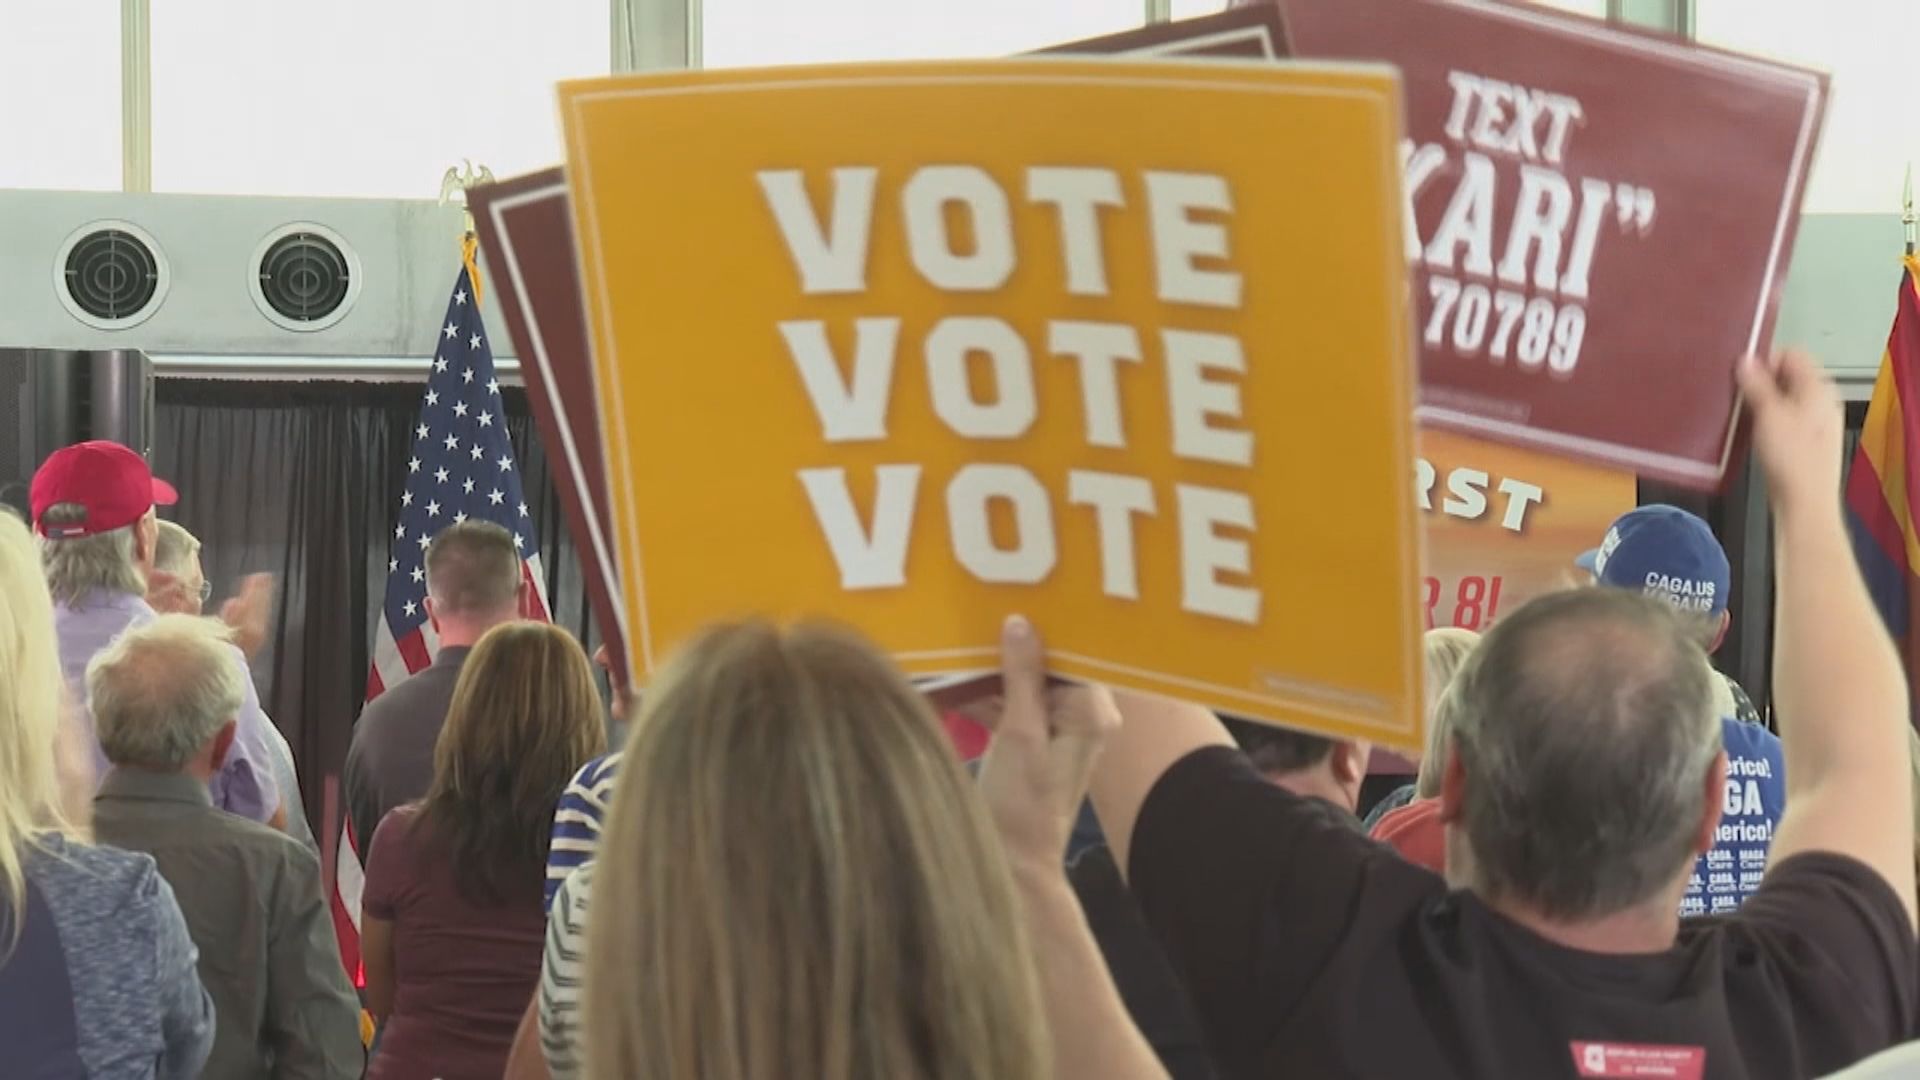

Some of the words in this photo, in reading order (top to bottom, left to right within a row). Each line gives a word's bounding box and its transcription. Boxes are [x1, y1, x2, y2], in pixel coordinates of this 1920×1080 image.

[1445, 70, 1583, 164] TEXT
[756, 164, 1244, 308] VOTE
[1424, 274, 1587, 374] 70789
[777, 315, 1255, 468] VOTE
[796, 463, 1262, 625] VOTE
[1645, 572, 1716, 598] CAGA.US
[1453, 576, 1503, 632] 8!
